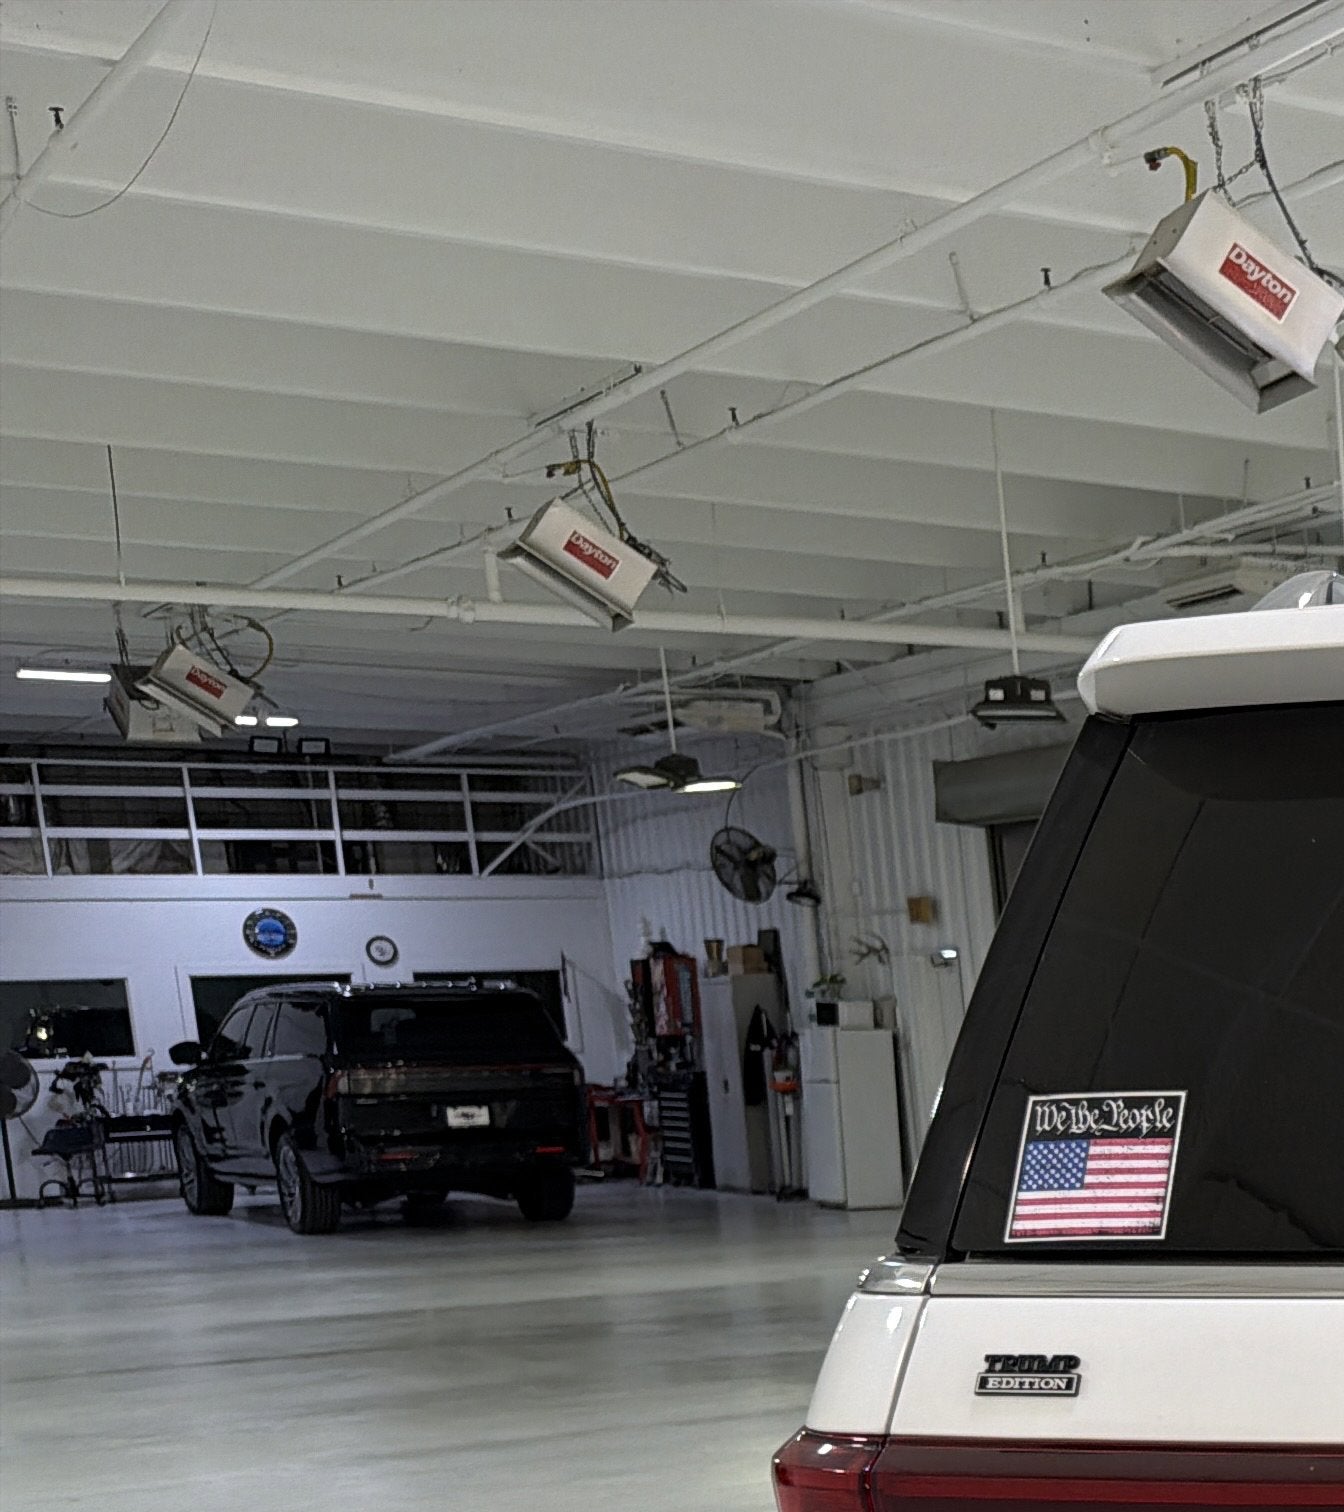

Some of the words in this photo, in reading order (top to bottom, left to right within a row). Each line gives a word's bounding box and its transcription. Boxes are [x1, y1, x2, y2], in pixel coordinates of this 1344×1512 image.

[1228, 246, 1295, 304] Dayton
[1035, 1101, 1070, 1135] We
[1061, 1100, 1103, 1136] The
[1099, 1098, 1176, 1139] People
[984, 1354, 1081, 1374] TRUMP
[986, 1377, 1069, 1390] EDITION
